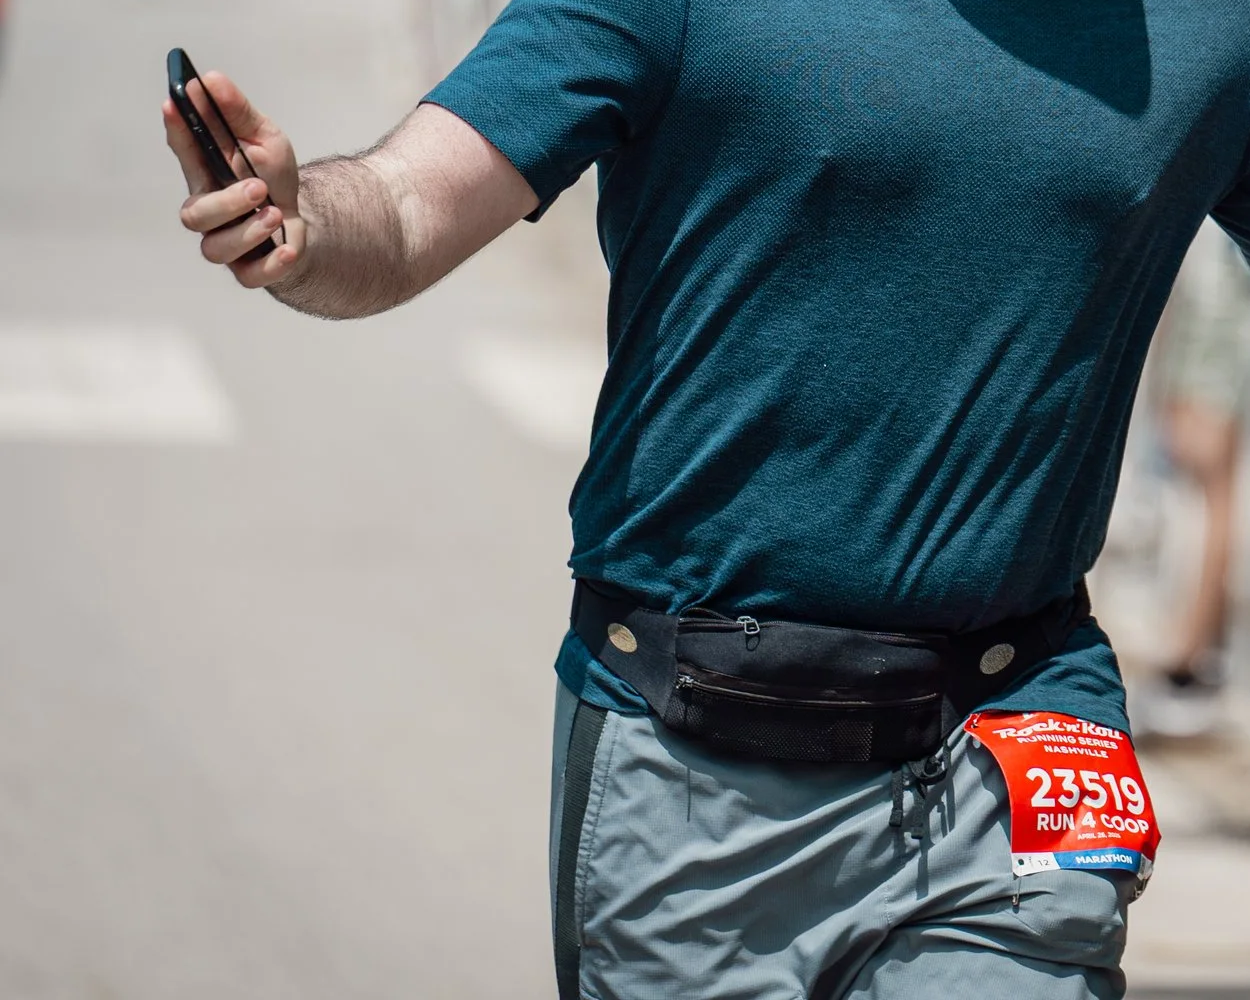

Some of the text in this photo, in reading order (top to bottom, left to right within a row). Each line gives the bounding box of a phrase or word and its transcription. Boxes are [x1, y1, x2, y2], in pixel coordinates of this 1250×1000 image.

[1017, 734, 1118, 750] RUNNING SERIES
[1044, 745, 1109, 758] NASHVILLE
[1026, 767, 1145, 815] 23519
[1037, 811, 1149, 834] RUN 4 COOP
[1077, 832, 1097, 840] APRIL
[1075, 853, 1133, 864] MARATHON
